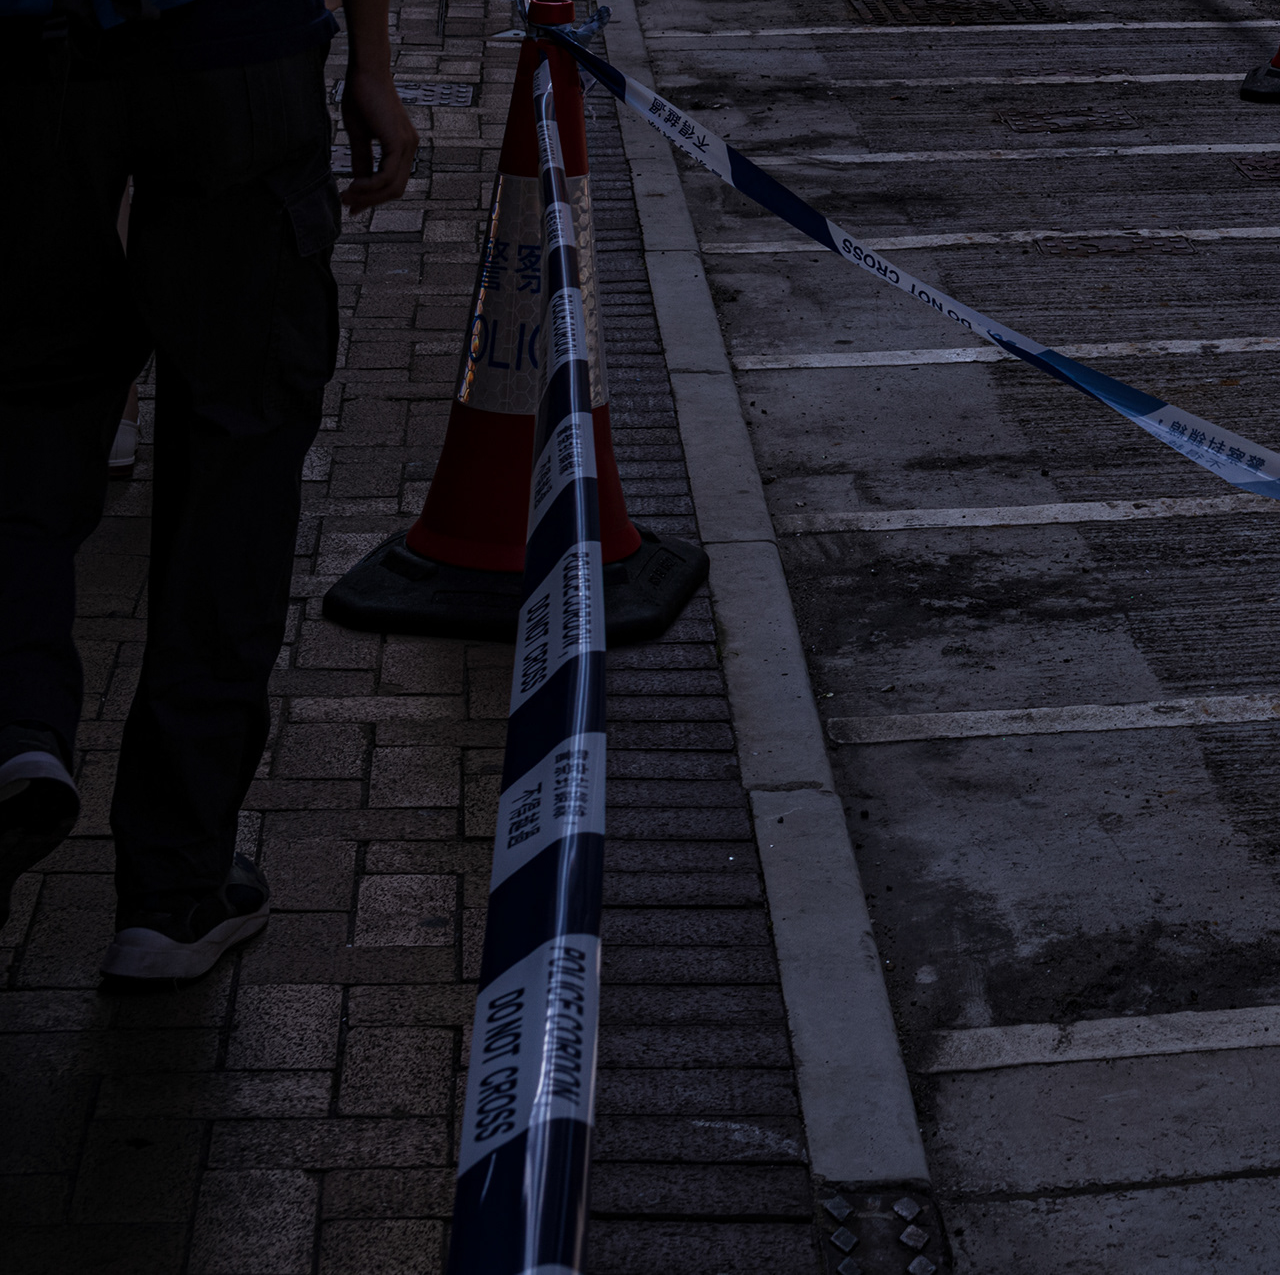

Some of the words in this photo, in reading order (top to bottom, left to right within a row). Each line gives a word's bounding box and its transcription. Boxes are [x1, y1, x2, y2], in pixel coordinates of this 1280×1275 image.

[648, 96, 710, 154] 不得越過
[842, 238, 900, 285] CROSS
[909, 282, 944, 313] NOT
[947, 309, 973, 330] DO
[468, 313, 540, 370] OLIC
[520, 645, 550, 695] CROSS
[487, 987, 524, 1025] DO
[482, 1021, 523, 1065] NOT
[552, 1015, 584, 1106] CORDON
[475, 1066, 518, 1143] CROSS
